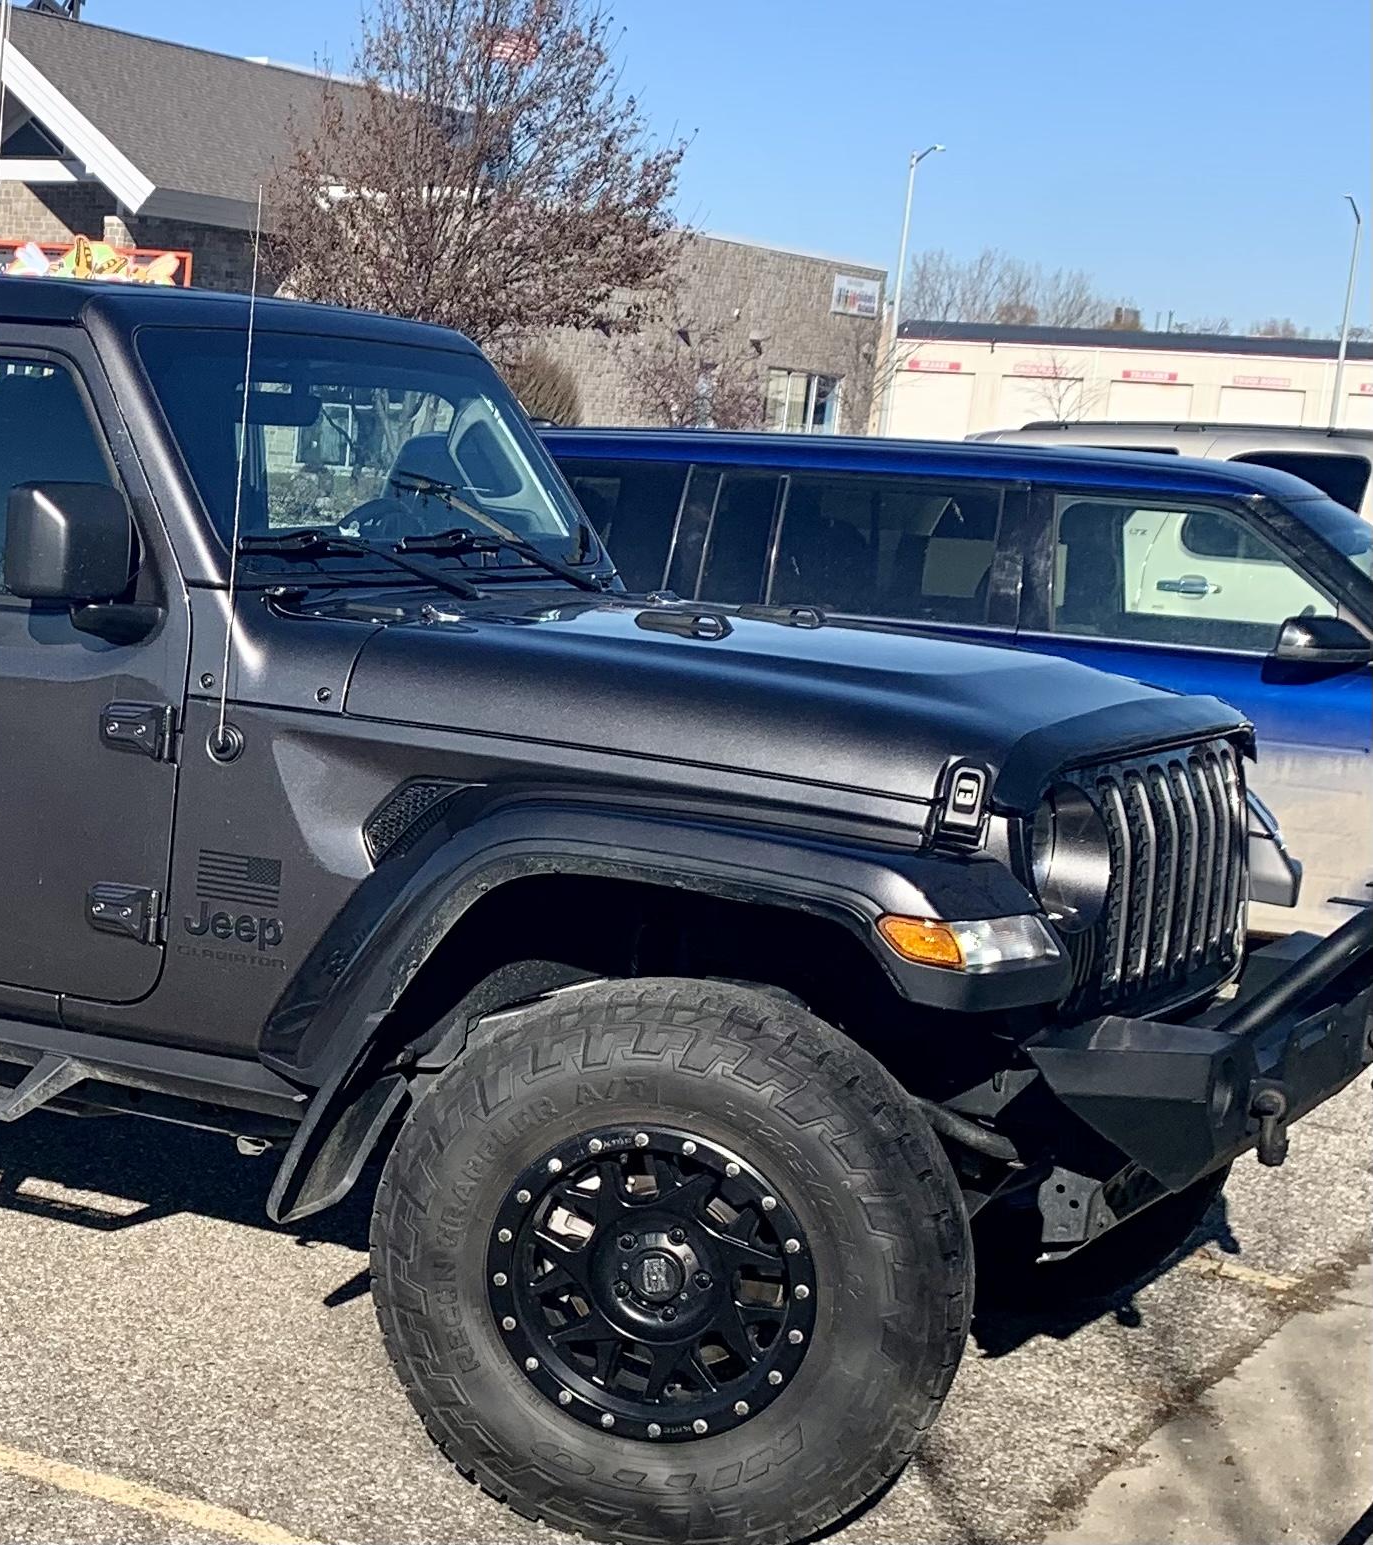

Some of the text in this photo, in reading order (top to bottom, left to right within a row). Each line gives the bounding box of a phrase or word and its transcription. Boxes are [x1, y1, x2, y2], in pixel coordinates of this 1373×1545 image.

[184, 901, 285, 951] Jeep
[177, 945, 285, 968] GLADIATOR
[430, 1076, 649, 1375] RECON GRAPPLER A/T
